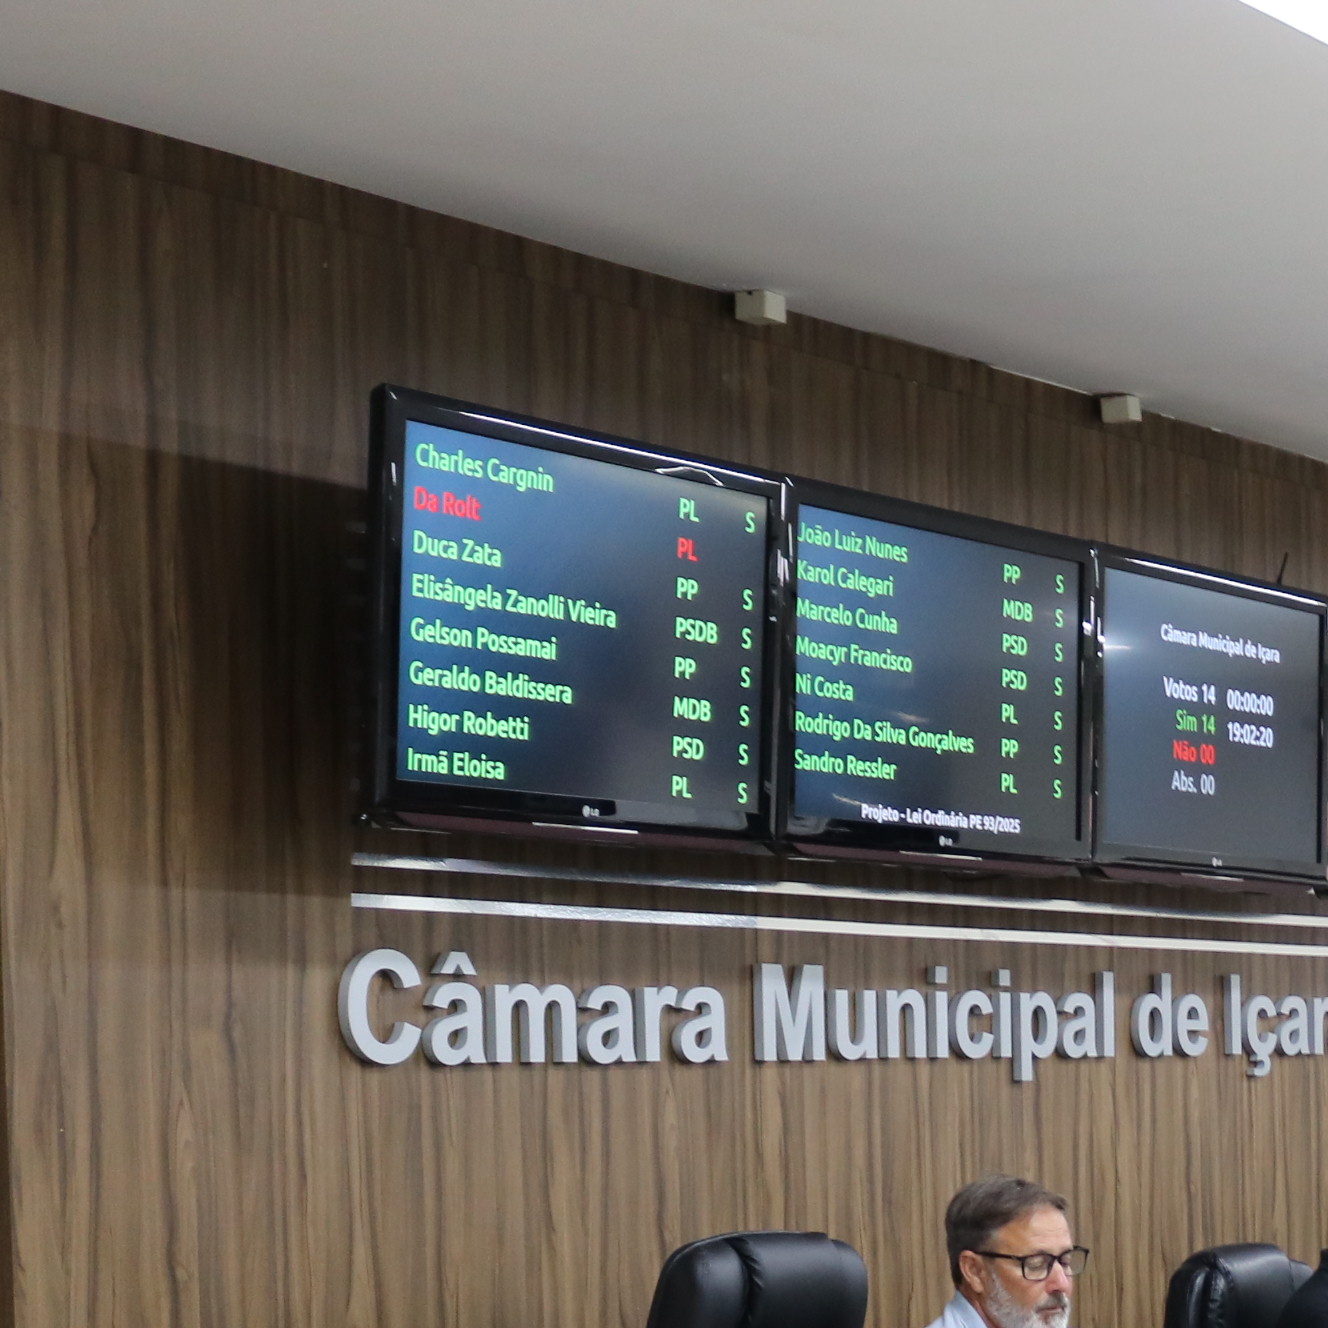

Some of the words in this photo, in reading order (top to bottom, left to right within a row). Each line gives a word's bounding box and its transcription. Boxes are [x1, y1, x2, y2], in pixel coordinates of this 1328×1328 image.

[416, 444, 483, 477] Charles
[487, 457, 554, 492] Cargnin
[679, 498, 699, 523] PL
[745, 511, 756, 533] S
[414, 486, 439, 512] Da
[443, 492, 482, 521] Rolt
[678, 537, 697, 562] PL
[413, 530, 458, 560] Duca
[462, 538, 502, 568] Zata
[677, 577, 698, 601] PP
[743, 588, 753, 611] S
[797, 521, 831, 548] João
[834, 529, 862, 554] Luiz
[866, 536, 908, 563] Nunes
[1003, 564, 1021, 584] PP
[1056, 575, 1064, 594] S
[412, 574, 502, 612] Elisângela
[505, 588, 564, 620] Zanolli
[569, 599, 616, 629] Vieira
[675, 617, 717, 644] PSDB
[742, 627, 752, 649] S
[798, 559, 834, 586] Karol
[838, 567, 893, 598] Calegari
[1003, 598, 1032, 623] MDB
[1055, 609, 1063, 628] S
[411, 617, 472, 649] Gelson
[477, 628, 557, 661] Possamai
[674, 657, 696, 680] PP
[740, 666, 751, 688] S
[797, 598, 852, 627] Marcelo
[856, 607, 898, 635] Cunha
[1002, 633, 1028, 657] PSD
[1055, 643, 1063, 662] S
[1161, 624, 1197, 647] Câmara
[1199, 631, 1243, 657] Municipal
[1245, 640, 1256, 658] de
[1258, 643, 1280, 664] Içara
[409, 661, 480, 692] Geraldo
[485, 671, 572, 704] Baldissera
[674, 697, 711, 722] MDB
[739, 705, 750, 727] S
[796, 635, 847, 665] Moacyr
[850, 644, 912, 673] Francisco
[1002, 668, 1027, 691] PSD
[1055, 677, 1062, 697] S
[1163, 676, 1198, 702] Votos
[1202, 683, 1216, 705] 14
[1227, 689, 1274, 716] 00:00:00
[796, 673, 811, 695] Ni
[814, 676, 853, 702] Costa
[1002, 703, 1018, 725] PL
[1054, 711, 1062, 730] S
[1176, 709, 1197, 732] Sim
[1202, 714, 1216, 735] 14
[1227, 722, 1273, 748] 19:02:20
[408, 704, 459, 738] Higor
[463, 711, 529, 741] Robetti
[673, 736, 704, 761] PSD
[739, 744, 749, 765] S
[795, 711, 850, 741] Rodrigo
[853, 718, 872, 742] Da
[875, 721, 905, 746] Silva
[909, 726, 974, 755] Gonçalves
[1001, 738, 1018, 759] PP
[1054, 745, 1062, 765] S
[1173, 739, 1197, 762] Não
[1200, 744, 1216, 765] 00
[407, 748, 448, 774] Irmã
[453, 753, 505, 780] Eloisa
[672, 776, 691, 799] PL
[738, 783, 748, 804] S
[795, 749, 843, 774] Sandro
[847, 755, 897, 780] Ressler
[1001, 773, 1017, 794] PL
[1053, 779, 1061, 799] S
[1171, 769, 1197, 793] Abs.
[1200, 773, 1215, 795] 00
[861, 803, 900, 824] Projeto
[906, 808, 922, 824] Lei
[923, 809, 968, 828] Ordinária
[969, 814, 982, 830] PE
[984, 816, 1020, 834] 93/2025
[339, 947, 728, 1067] Câmara
[753, 962, 1116, 1082] Municipal
[1131, 971, 1209, 1059] de
